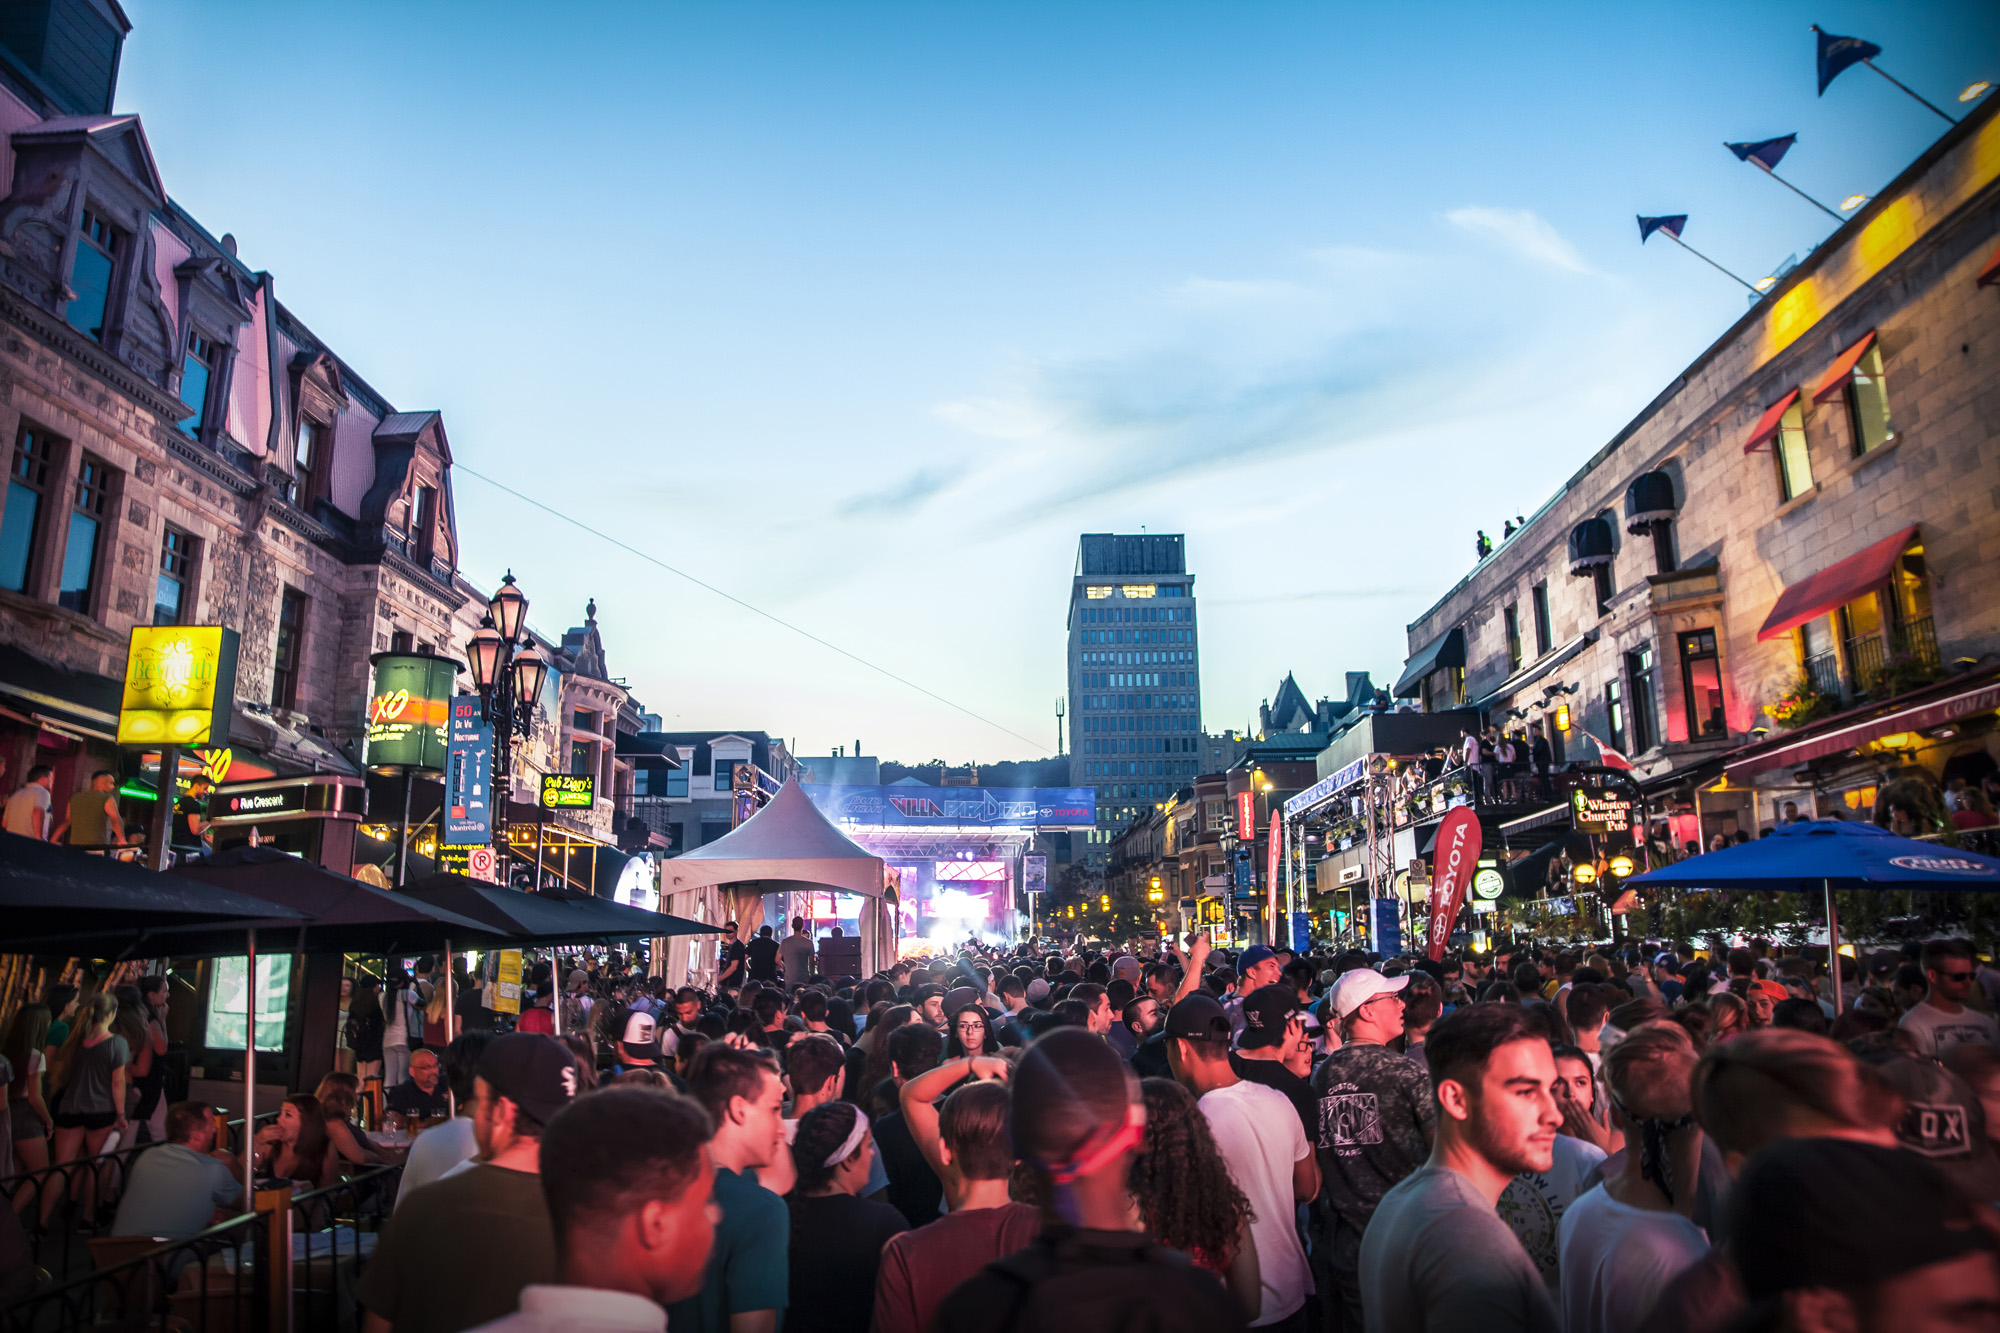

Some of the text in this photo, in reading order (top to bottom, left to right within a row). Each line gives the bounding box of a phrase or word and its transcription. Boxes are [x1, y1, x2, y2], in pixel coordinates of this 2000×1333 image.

[372, 689, 409, 727] XO
[455, 705, 473, 717] 50
[201, 748, 232, 783] XO
[545, 775, 593, 792] Pub Ziggy's
[240, 794, 284, 810] Rue Crescent
[560, 792, 590, 803] JAMESON
[850, 795, 883, 805] BUD
[1604, 791, 1618, 801] Sir
[841, 803, 887, 814] LIGHT
[888, 789, 1036, 822] VILLA PARADIZO
[1588, 799, 1632, 811] Winston
[1054, 808, 1089, 817] TOYOTA
[1578, 809, 1627, 822] Churchill
[450, 823, 477, 832] Montréal
[1606, 820, 1628, 831] Pub
[1440, 823, 1468, 909] TOYOTA
[1328, 1083, 1360, 1095] CUSTOM
